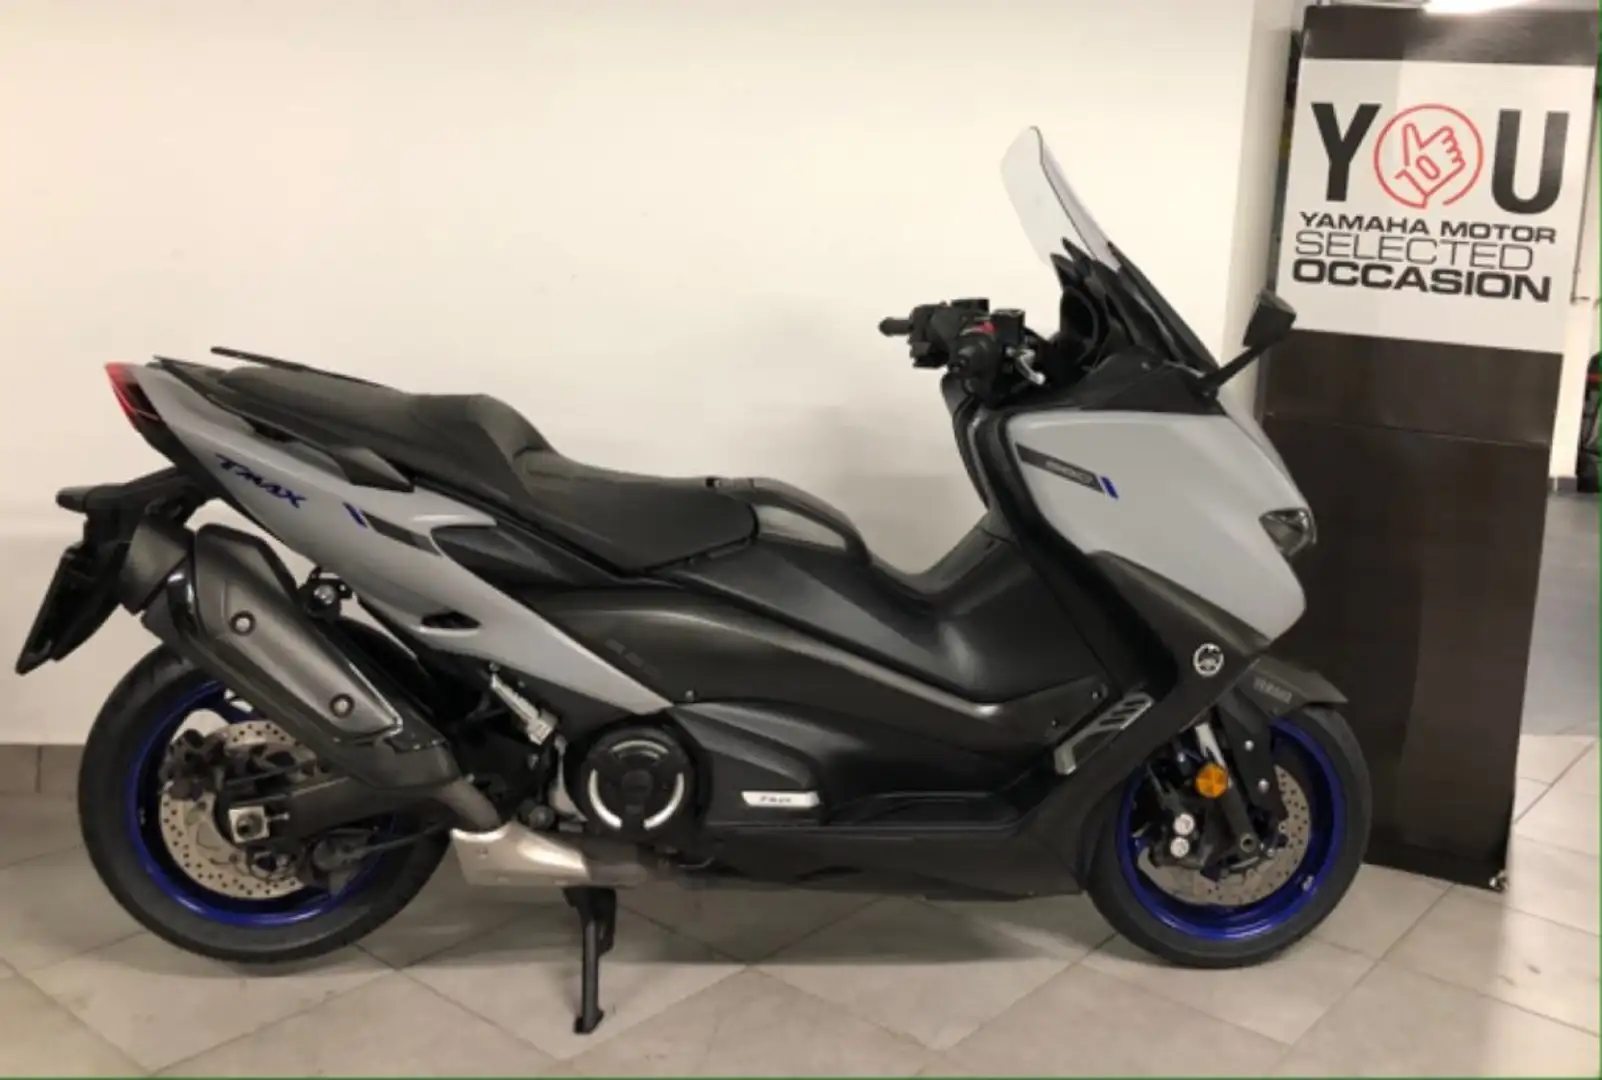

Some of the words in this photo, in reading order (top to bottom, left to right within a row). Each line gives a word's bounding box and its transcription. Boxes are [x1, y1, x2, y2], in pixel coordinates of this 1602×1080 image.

[1299, 211, 1431, 236] YAMAHA
[1440, 219, 1557, 244] MOTOR
[1295, 230, 1534, 271] SELECTED
[1292, 258, 1551, 303] OCCASION
